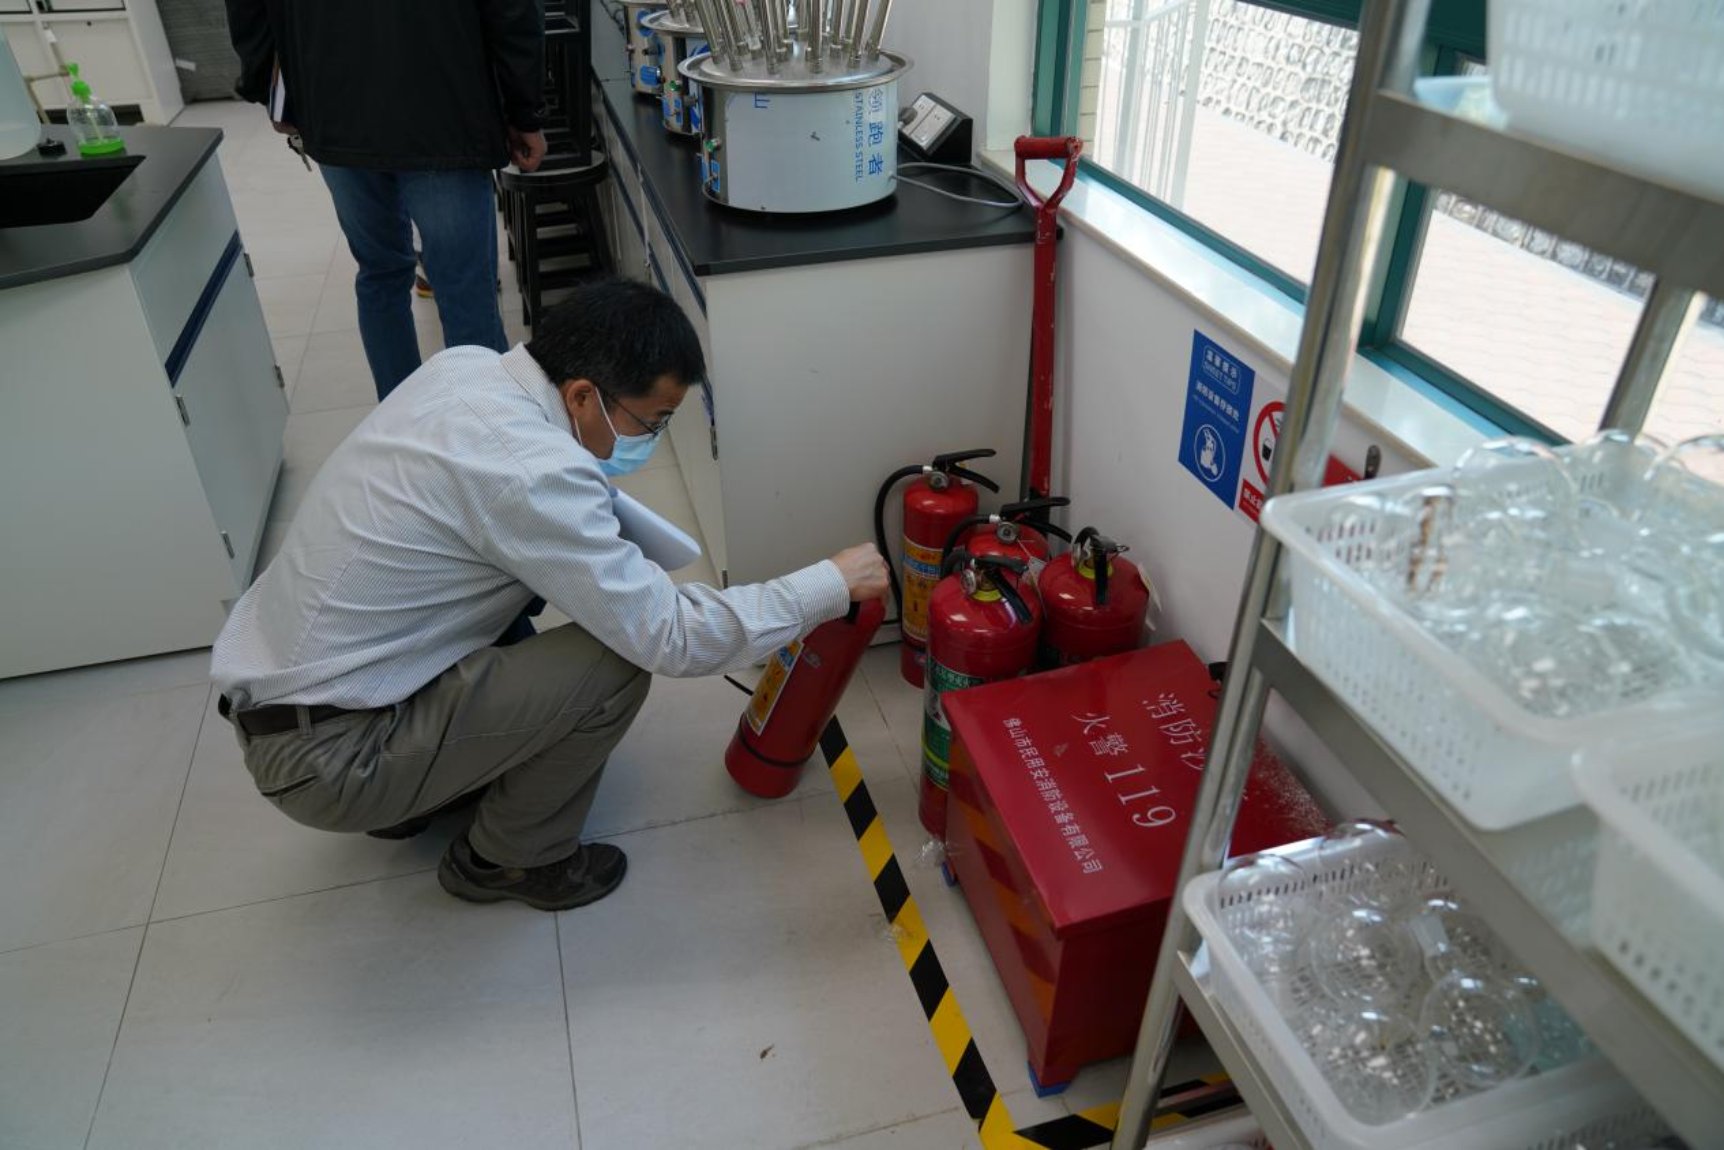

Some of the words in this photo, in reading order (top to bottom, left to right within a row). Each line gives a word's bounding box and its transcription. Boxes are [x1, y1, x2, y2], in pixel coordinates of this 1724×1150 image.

[855, 91, 864, 150] STAINLESS
[868, 88, 884, 176] 领跑者
[855, 151, 864, 184] STEEL
